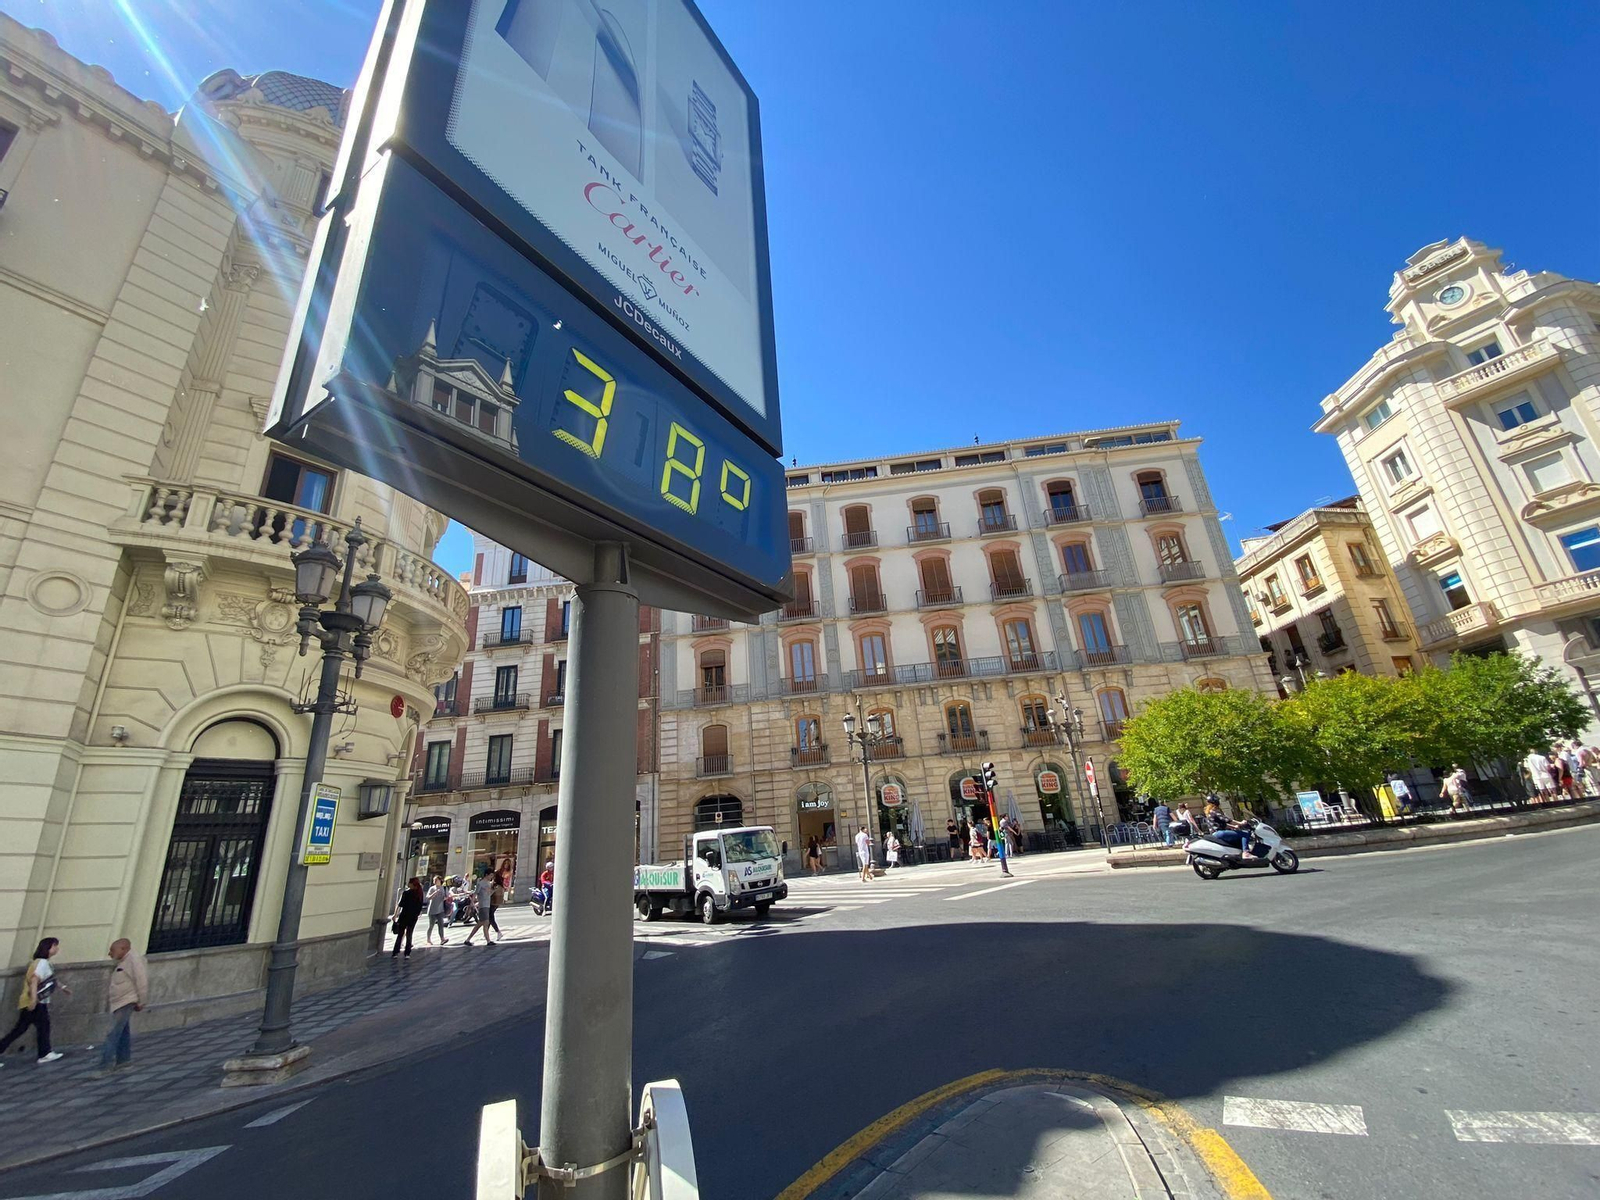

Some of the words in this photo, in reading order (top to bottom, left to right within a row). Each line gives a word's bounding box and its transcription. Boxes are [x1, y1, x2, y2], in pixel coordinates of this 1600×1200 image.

[576, 139, 622, 191] TANK
[629, 193, 707, 280] FRANÇAISE
[583, 181, 700, 297] Cartier
[598, 241, 638, 283] MIGUEL
[658, 297, 690, 333] MUÑOZ
[614, 295, 683, 360] JCDecaux
[315, 826, 330, 837] TAXI
[475, 817, 515, 825] intimissimi
